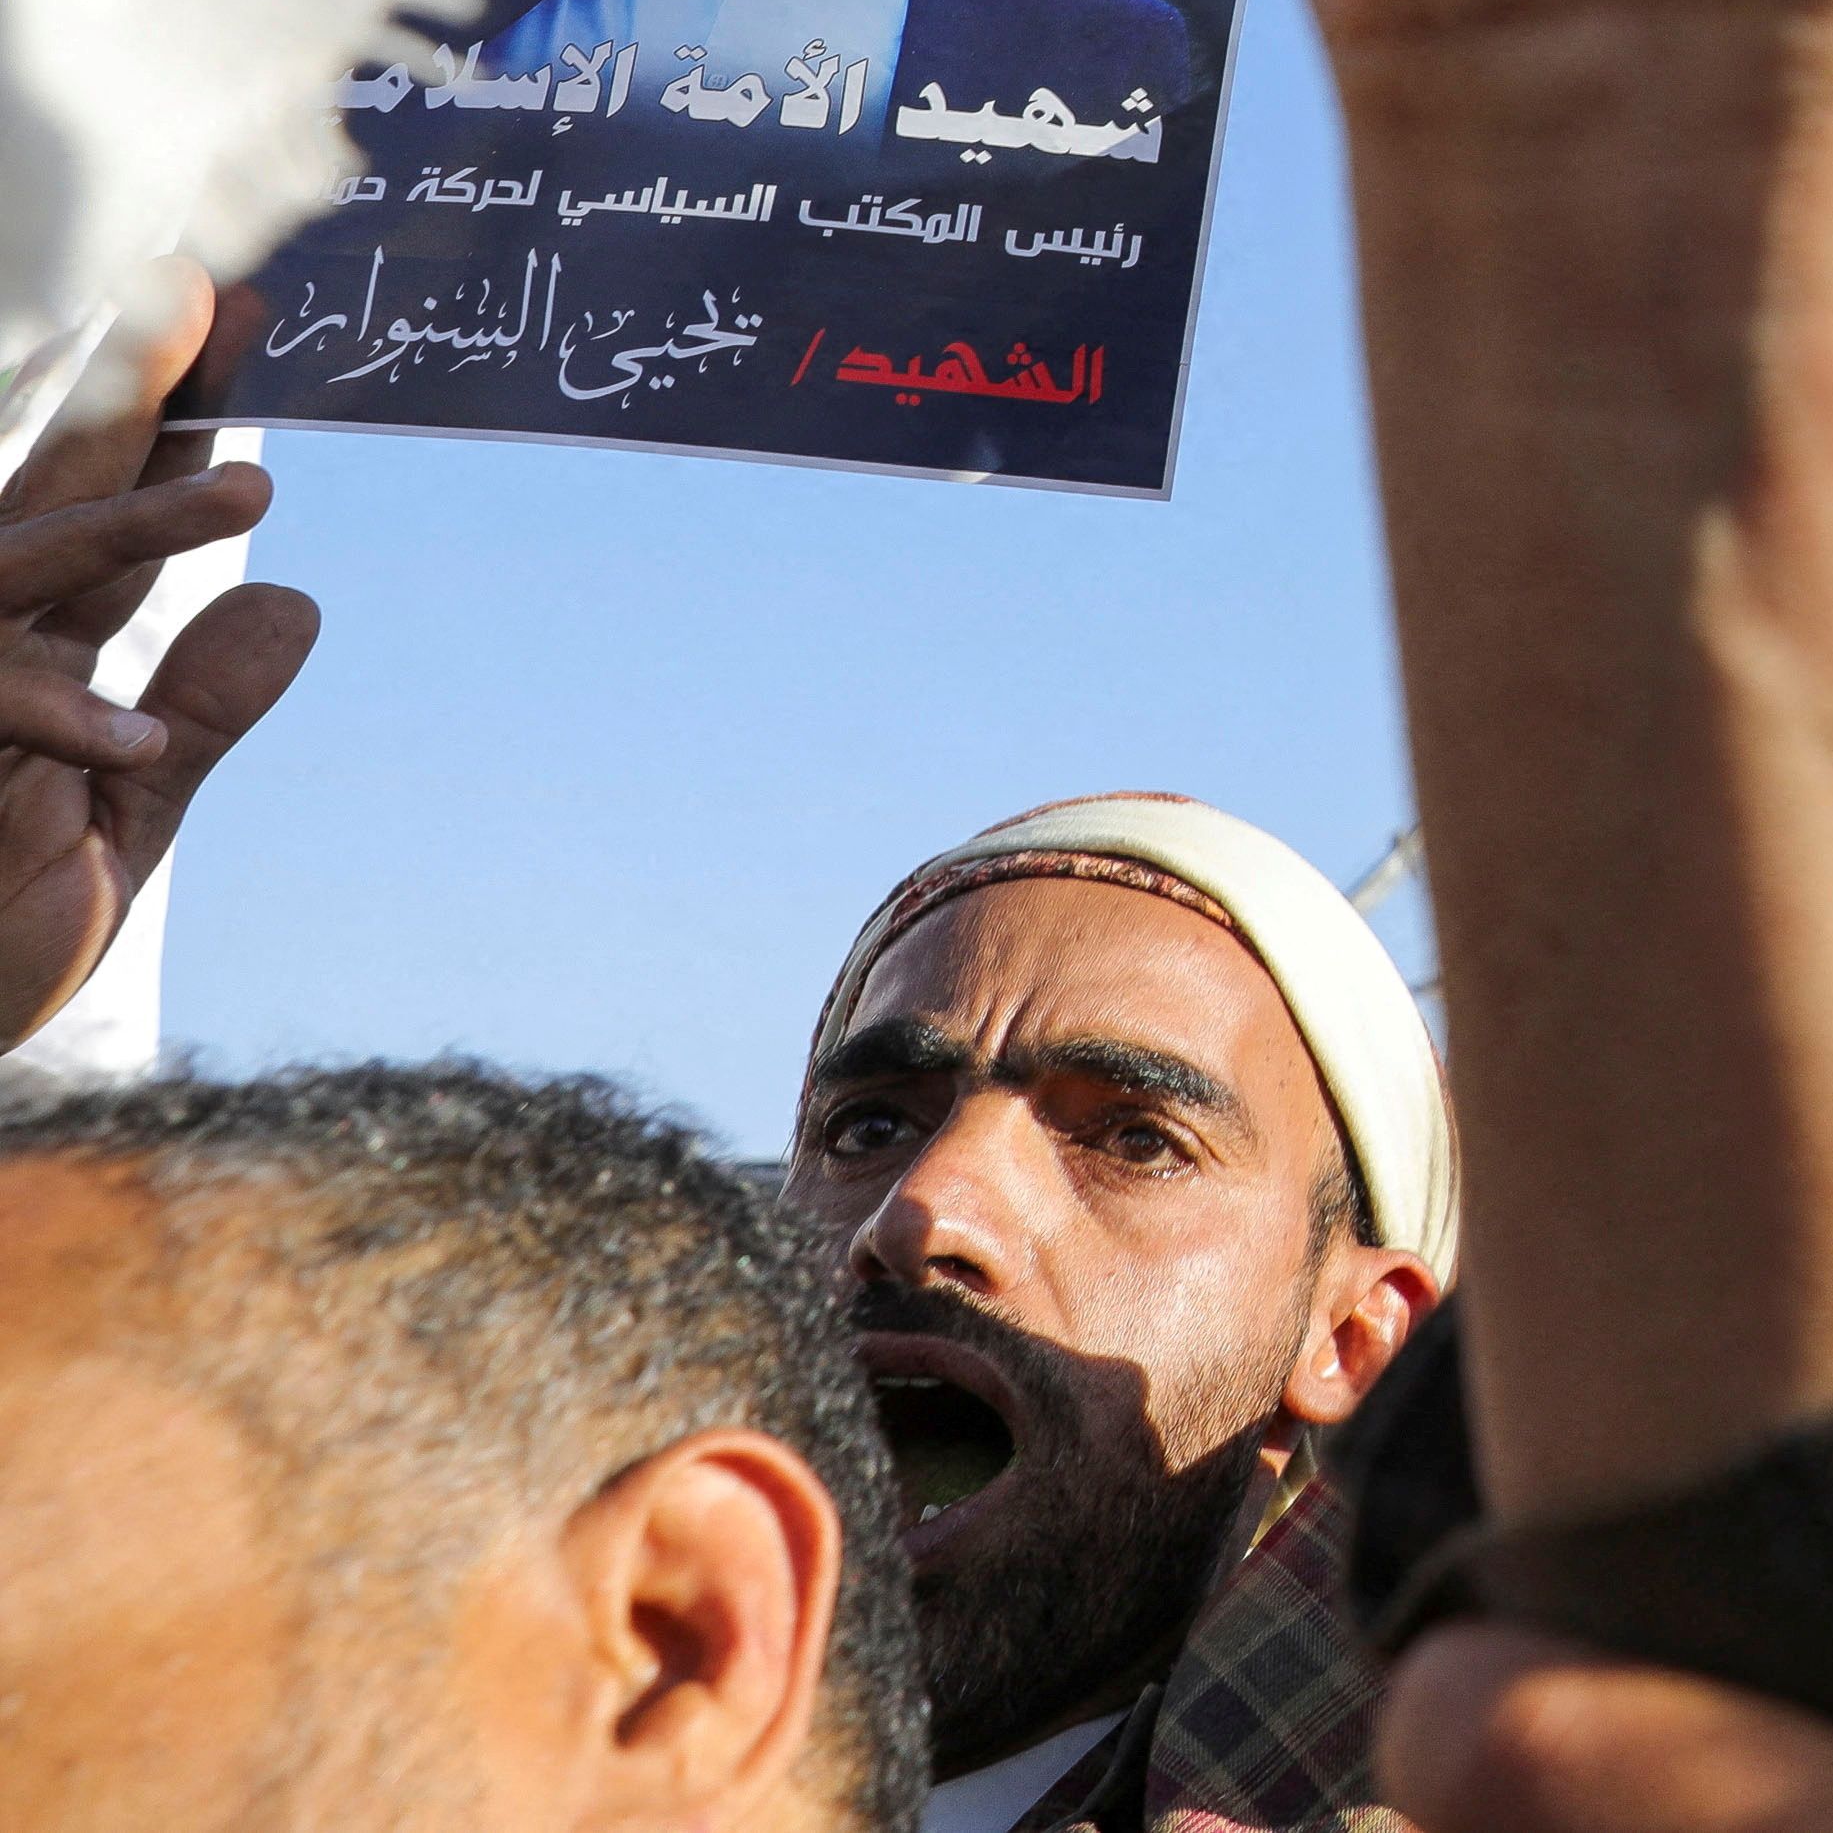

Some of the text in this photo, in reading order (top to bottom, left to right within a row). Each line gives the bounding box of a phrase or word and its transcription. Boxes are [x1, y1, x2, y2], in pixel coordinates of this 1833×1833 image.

[318, 35, 1162, 165] شهيد الأمة الإسلامي
[406, 166, 543, 212] لحركة
[557, 182, 777, 228] السياسي
[798, 193, 980, 245] المكتب
[1004, 219, 1142, 268] رئيس
[265, 244, 562, 386] السنوار
